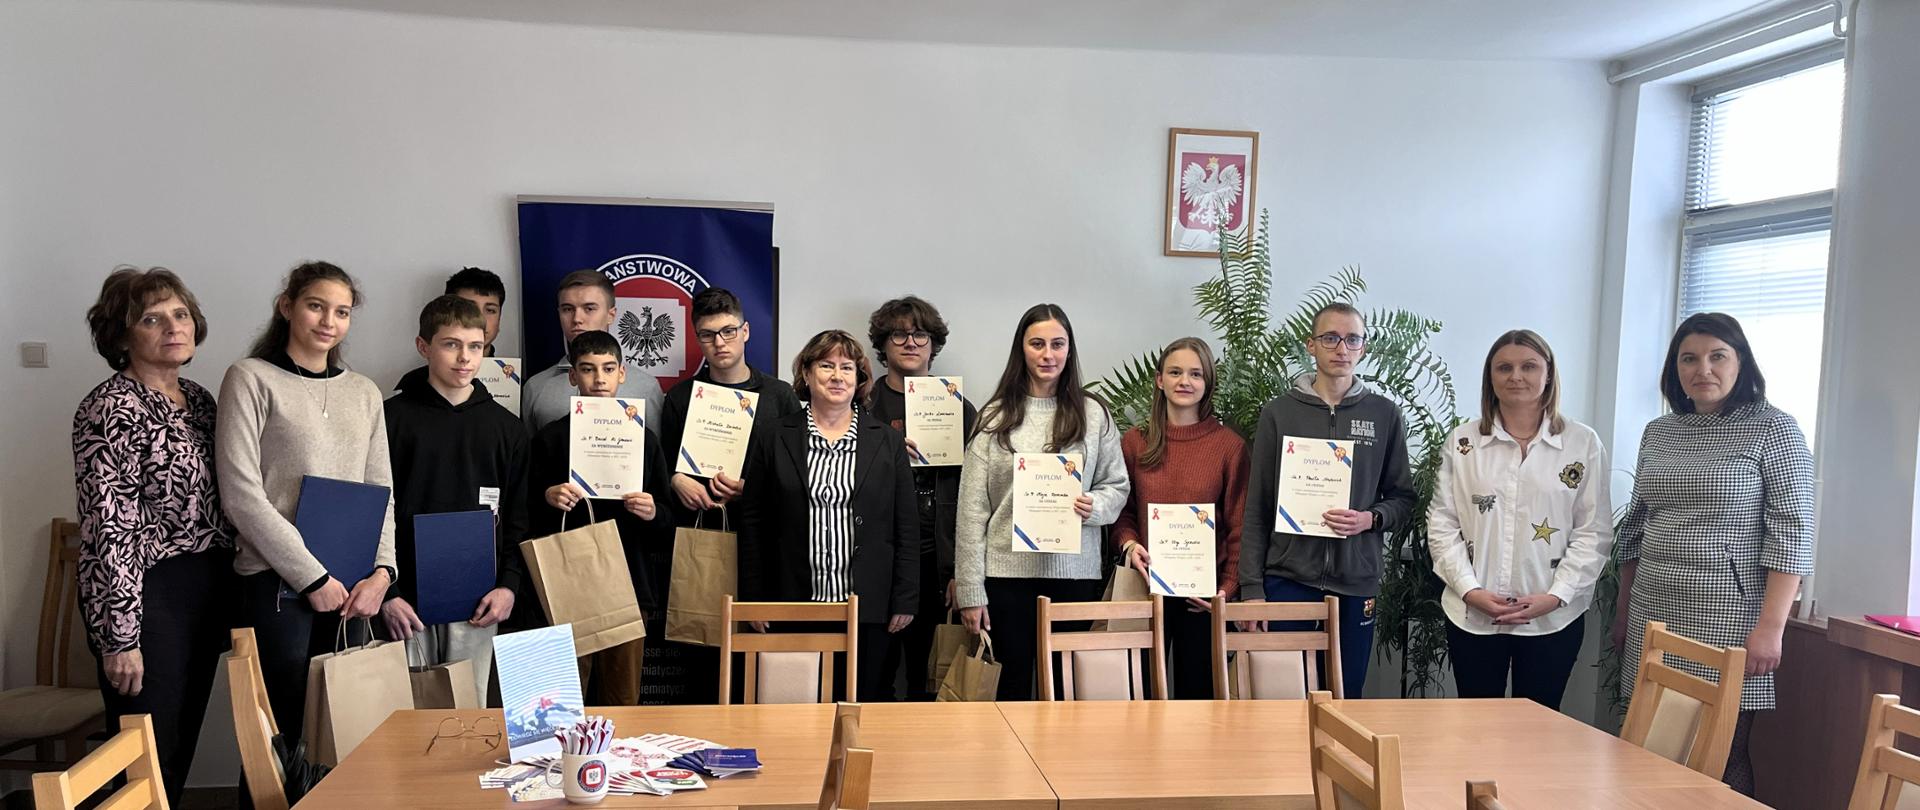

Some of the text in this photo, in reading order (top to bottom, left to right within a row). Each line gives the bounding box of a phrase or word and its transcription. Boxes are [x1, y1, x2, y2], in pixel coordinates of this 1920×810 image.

[604, 260, 697, 293] AŃSTWOWA
[710, 404, 736, 414] DYPLOM
[1351, 420, 1375, 430] SKATE
[1351, 428, 1376, 438] NATION
[1303, 458, 1331, 466] DYPLOM
